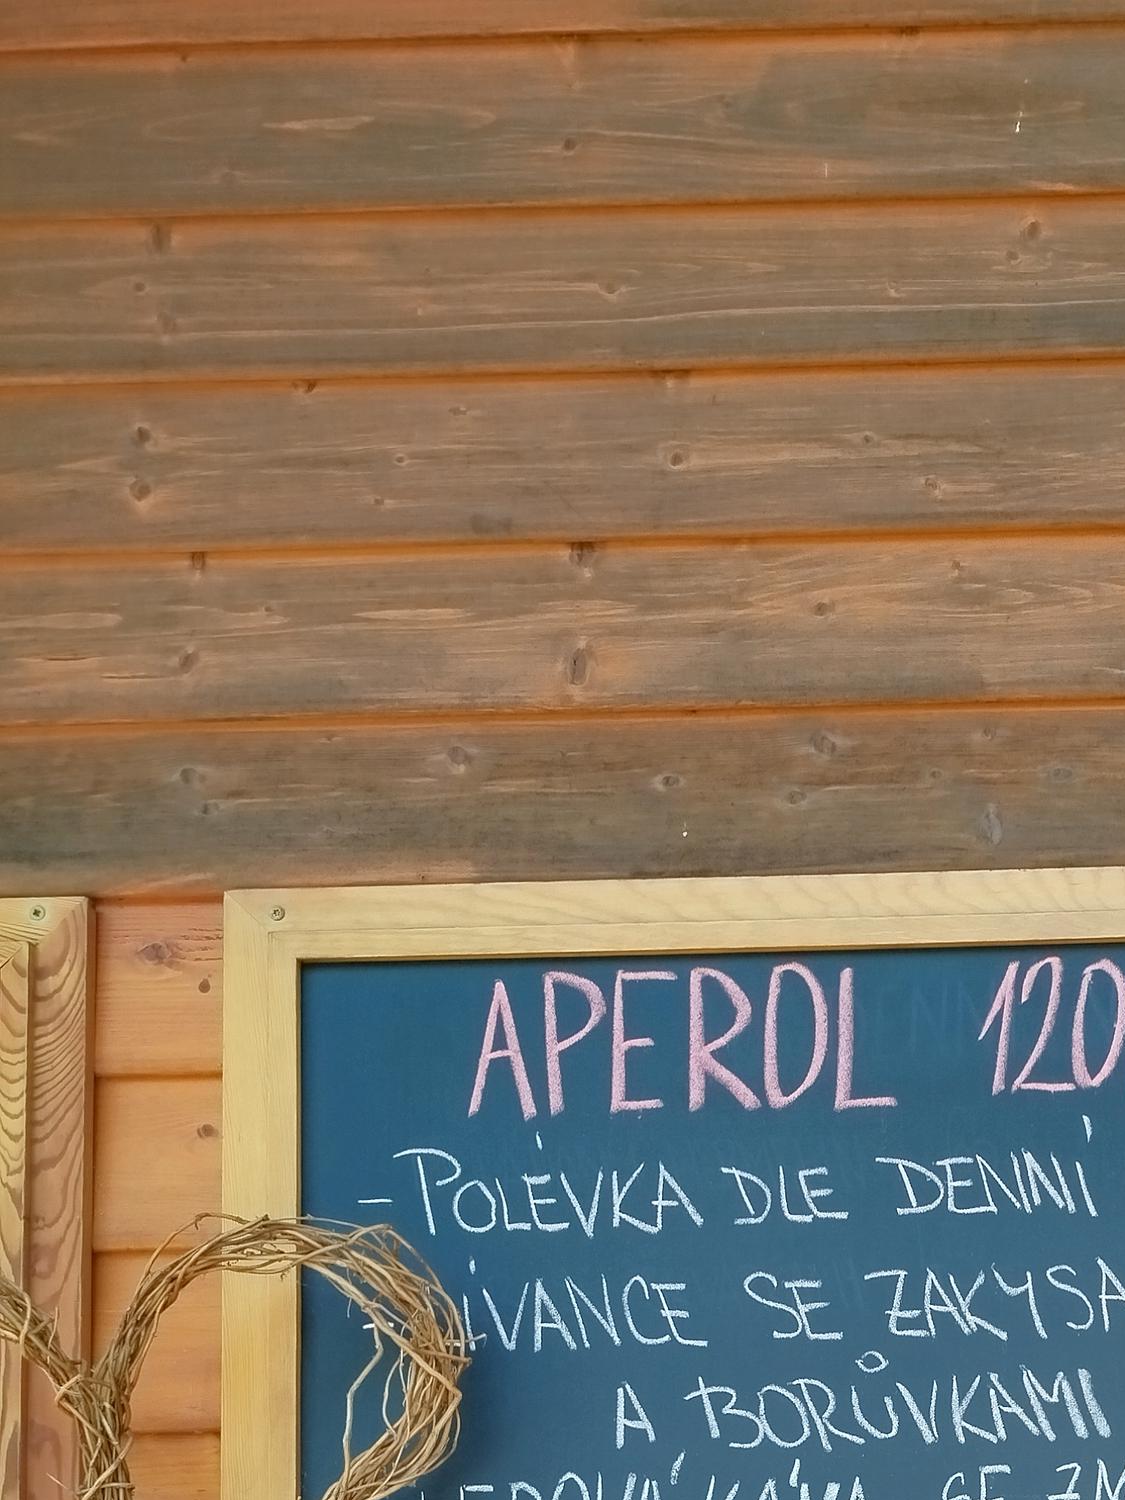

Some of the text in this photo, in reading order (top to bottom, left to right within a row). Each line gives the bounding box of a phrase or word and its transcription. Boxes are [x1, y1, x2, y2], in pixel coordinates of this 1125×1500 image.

[468, 961, 897, 1120] APEROL
[720, 1165, 849, 1225] DLE
[875, 1115, 1098, 1217] DENNÍ
[743, 1270, 844, 1340] SE
[616, 1383, 657, 1449] A
[684, 1350, 1112, 1453] BORŮVKAMI
